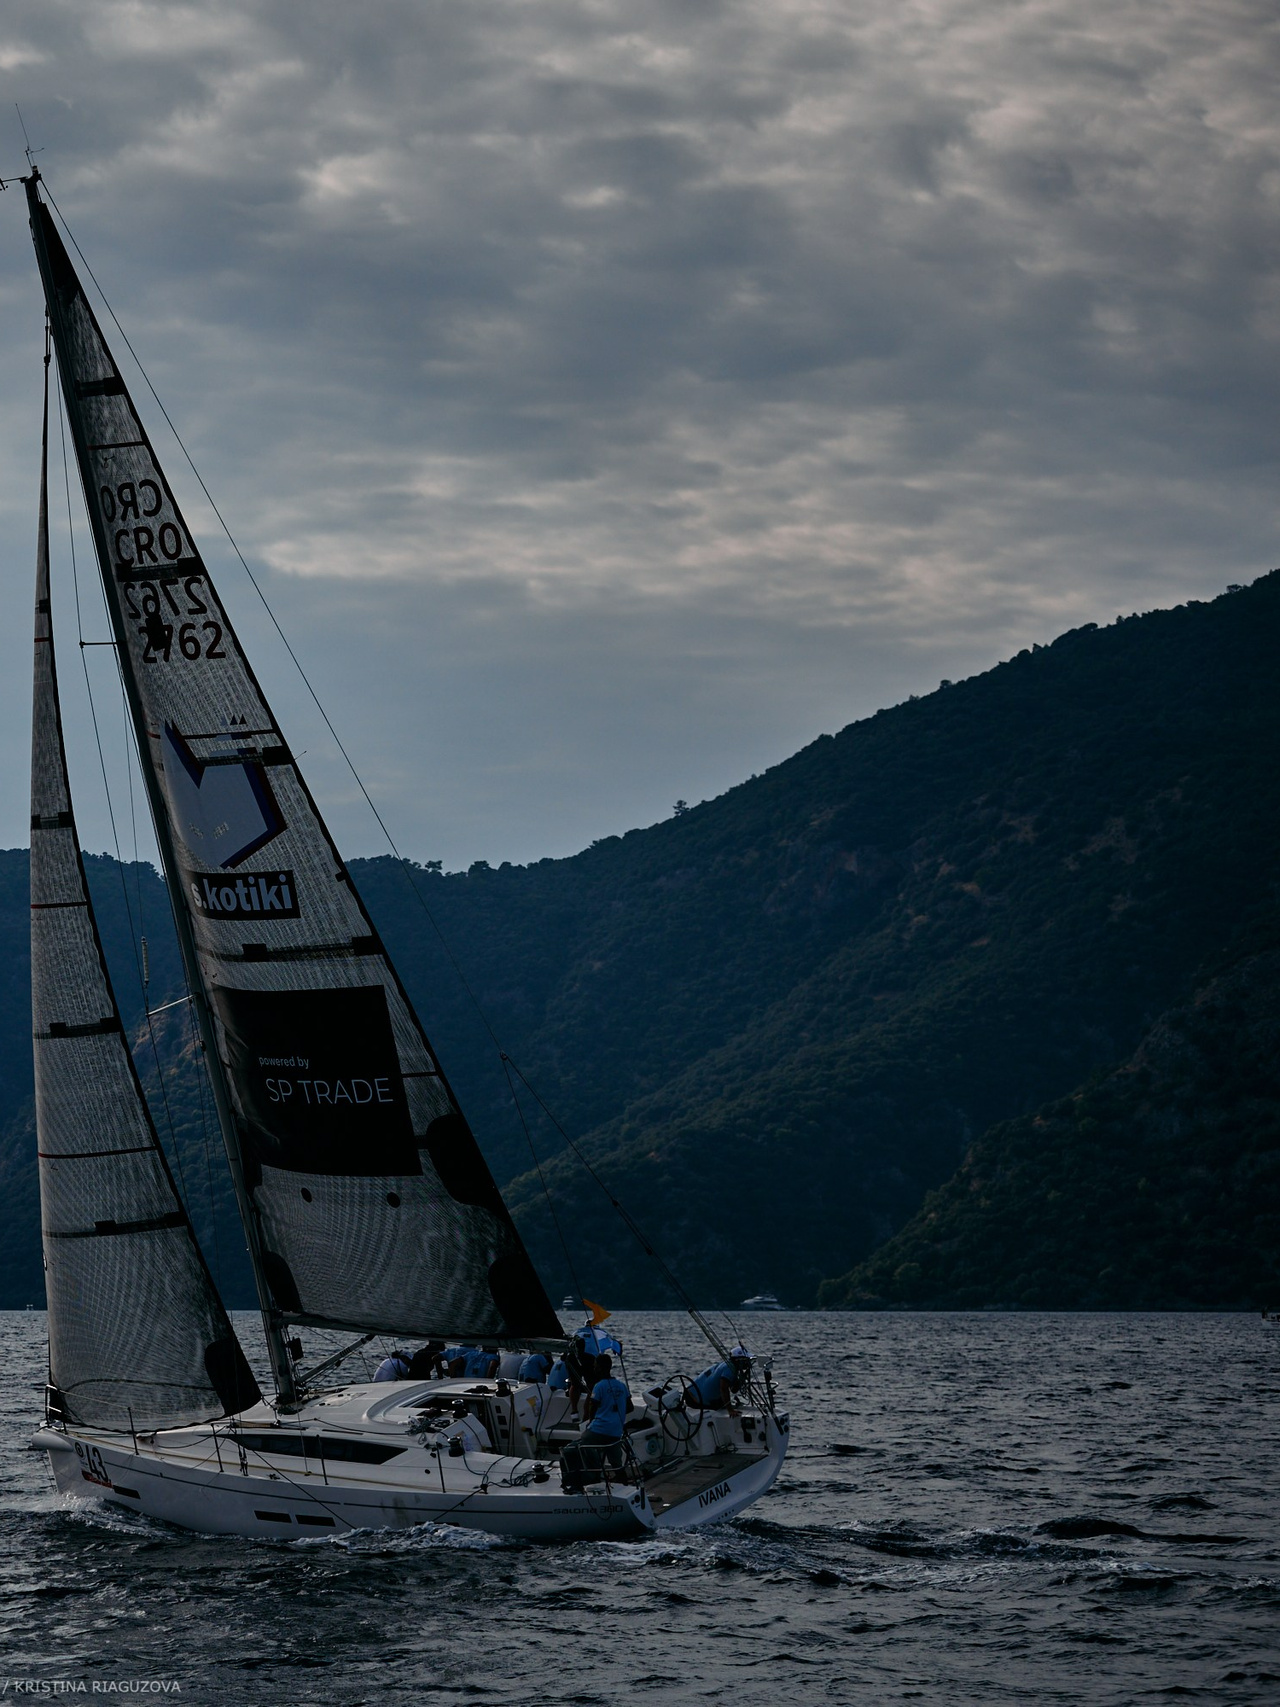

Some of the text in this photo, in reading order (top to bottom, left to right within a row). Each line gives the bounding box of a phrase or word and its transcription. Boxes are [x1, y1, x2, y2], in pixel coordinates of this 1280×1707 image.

[115, 522, 182, 567] CRO
[258, 1056, 310, 1070] powered by
[265, 1077, 394, 1105] SP TRADE
[85, 1444, 109, 1483] 43
[698, 1481, 732, 1508] IVANA
